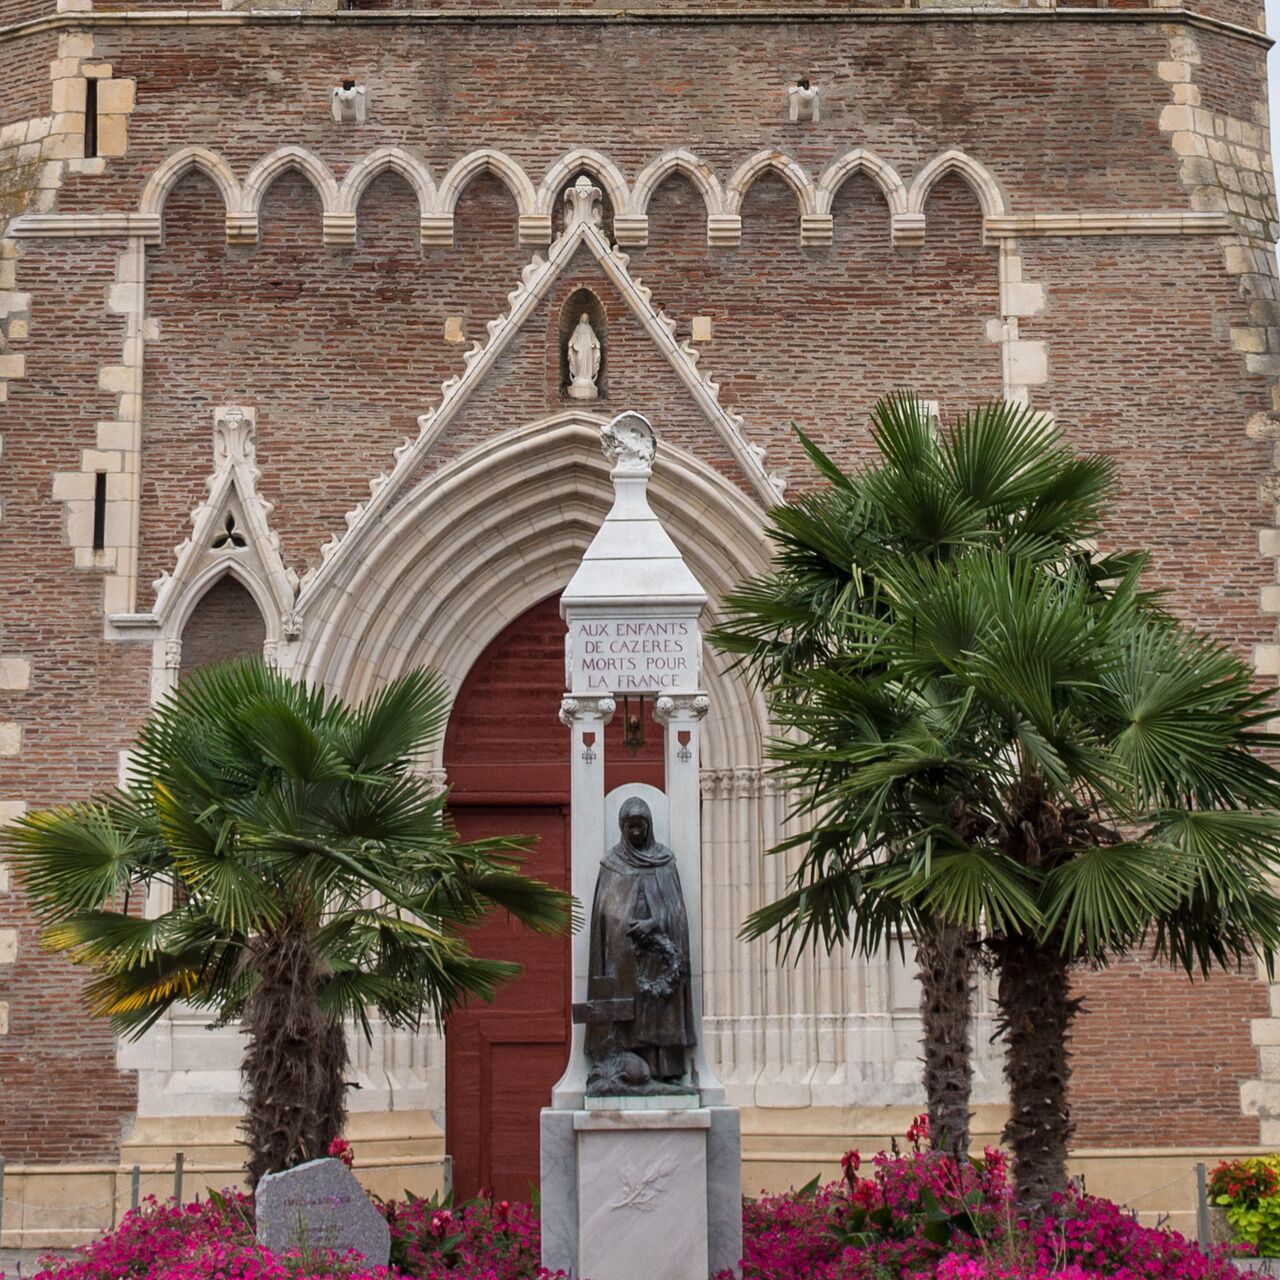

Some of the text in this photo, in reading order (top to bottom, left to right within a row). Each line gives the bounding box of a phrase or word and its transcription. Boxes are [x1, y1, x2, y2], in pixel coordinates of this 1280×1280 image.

[579, 622, 688, 637] AUX ENFANTS
[585, 640, 683, 654] DE CAZERES
[582, 657, 688, 671] MORTS POUR
[588, 674, 680, 688] LA FRANCE
